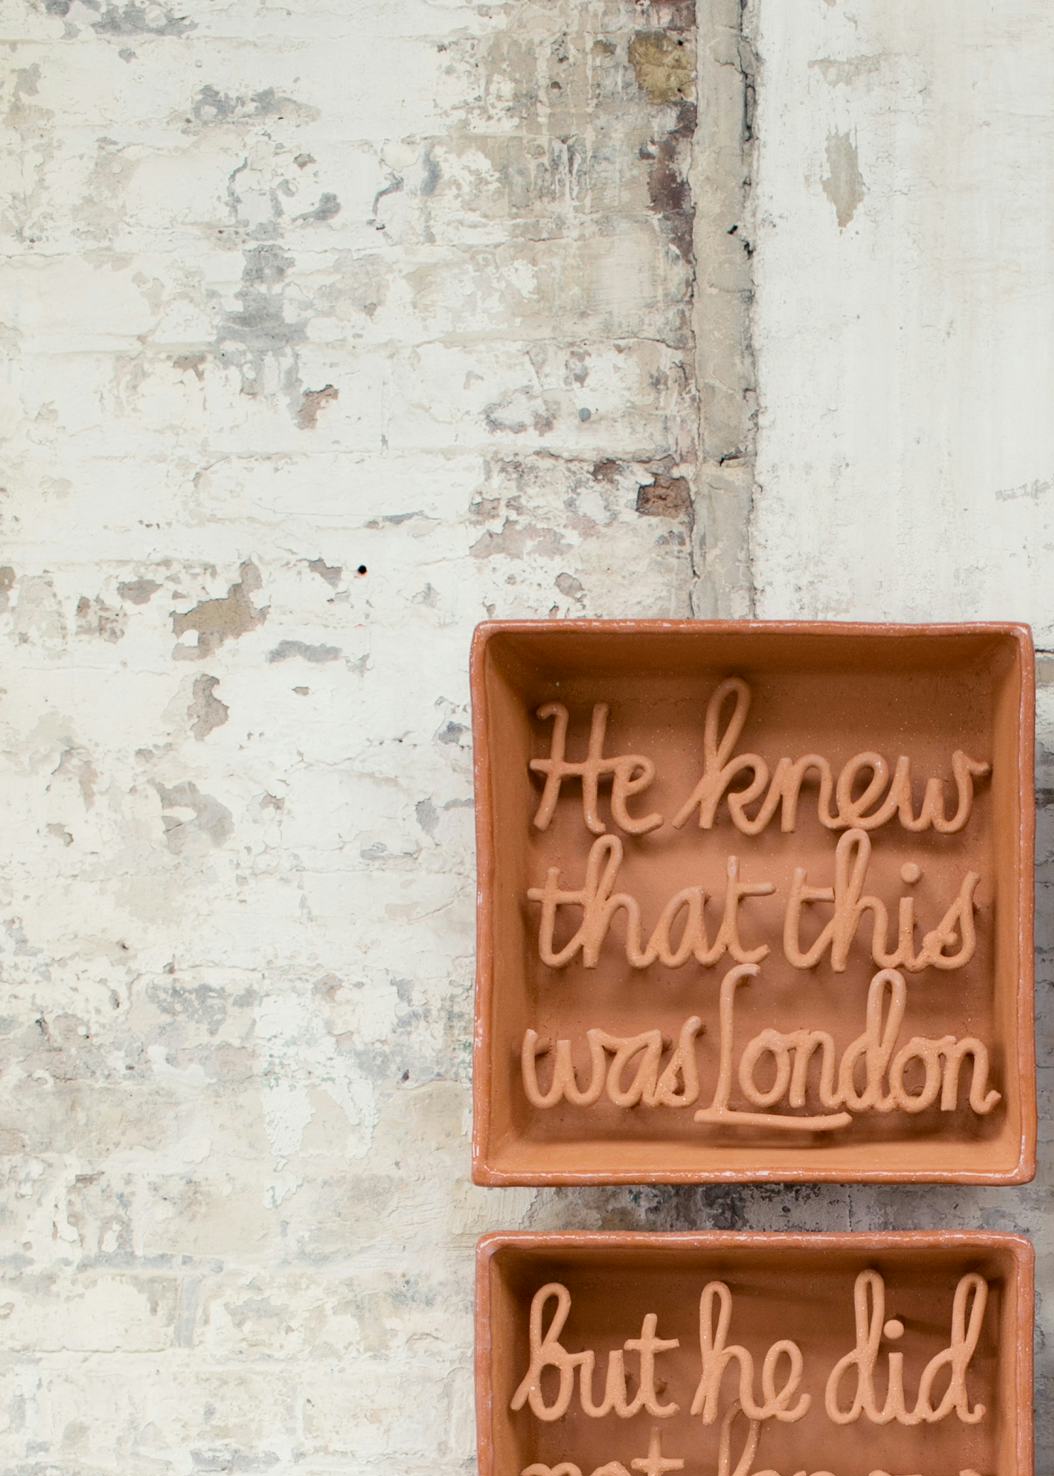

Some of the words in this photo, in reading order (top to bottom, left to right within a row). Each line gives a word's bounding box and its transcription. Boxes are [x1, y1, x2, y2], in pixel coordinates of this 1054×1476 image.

[529, 703, 663, 835] He
[672, 677, 989, 836] knew
[527, 834, 776, 969] that
[783, 828, 981, 973] this
[522, 1016, 706, 1108] was
[694, 964, 1001, 1131] London
[510, 1282, 680, 1422] but
[691, 1280, 811, 1425] he
[825, 1269, 988, 1425] did
